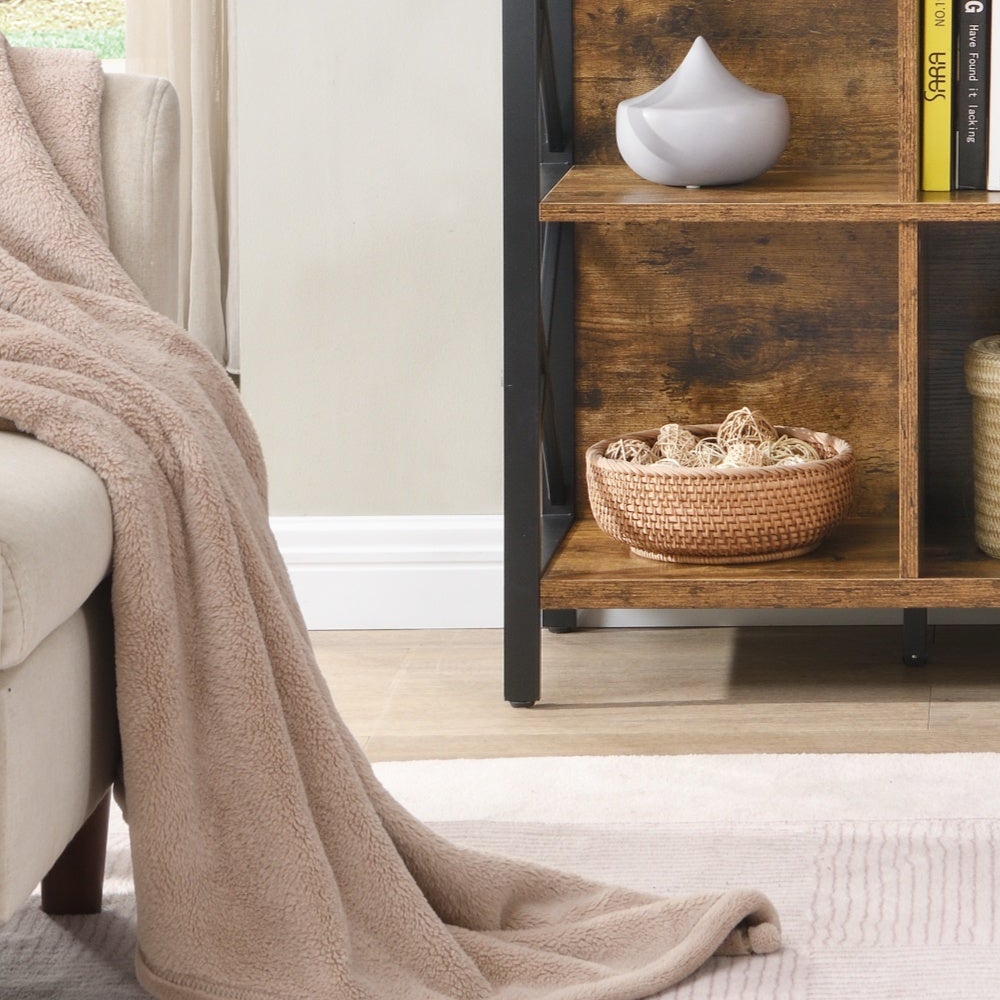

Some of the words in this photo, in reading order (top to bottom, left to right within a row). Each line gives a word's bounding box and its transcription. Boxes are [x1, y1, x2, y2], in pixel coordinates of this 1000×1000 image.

[968, 24, 980, 48] Have
[968, 52, 980, 81] Found
[967, 87, 978, 98] it
[966, 104, 979, 144] lacking
